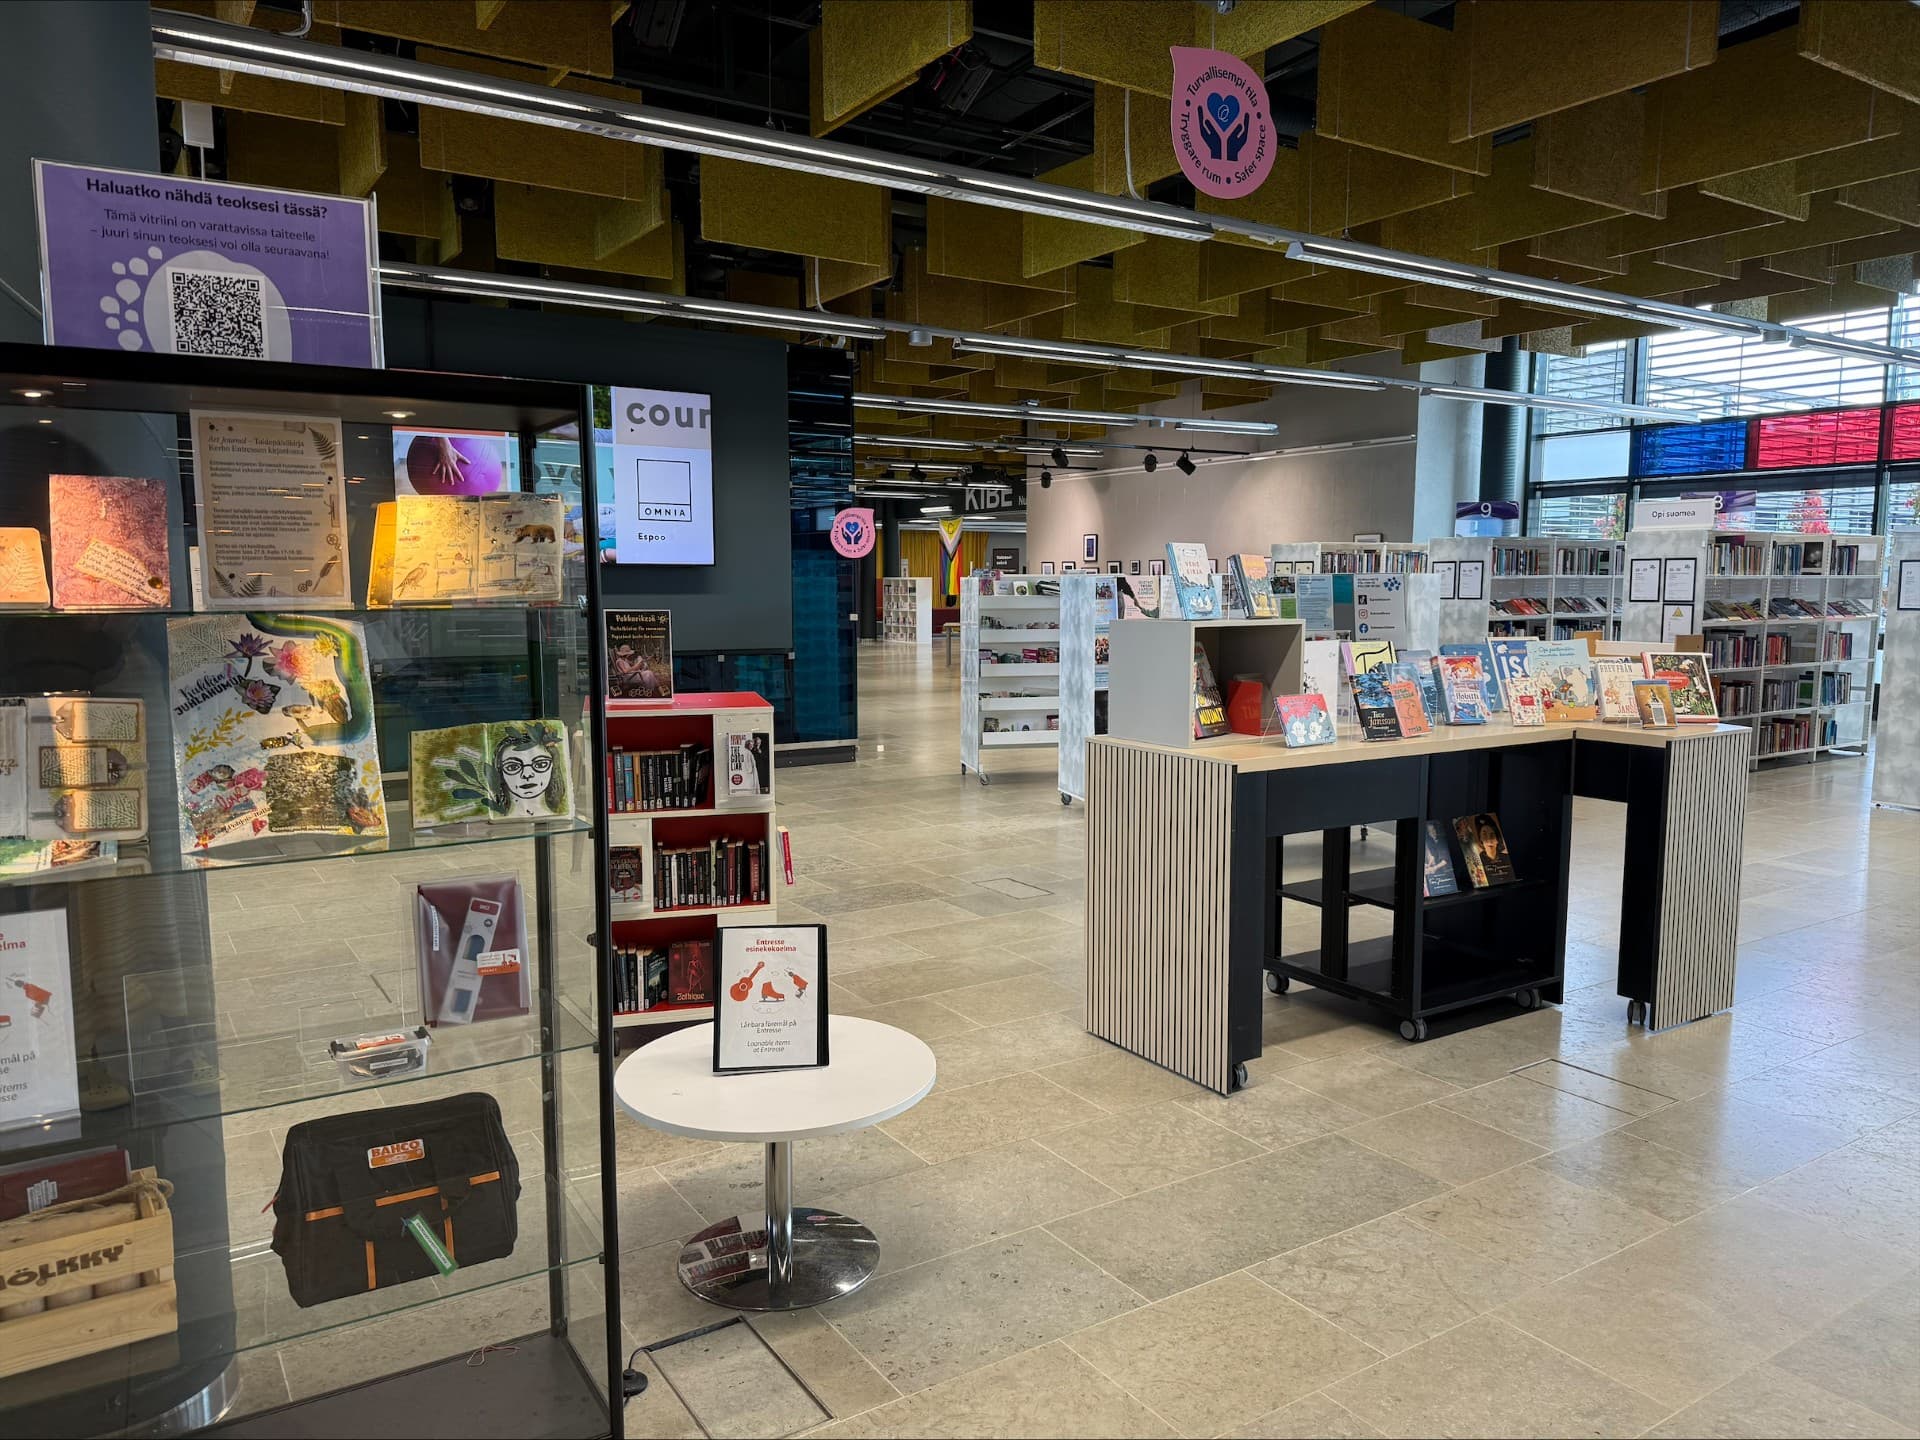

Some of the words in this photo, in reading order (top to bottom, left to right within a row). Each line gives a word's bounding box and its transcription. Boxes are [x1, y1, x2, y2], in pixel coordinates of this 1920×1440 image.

[1186, 65, 1247, 96] Turvallisempi
[1245, 86, 1258, 108] tila
[1179, 111, 1201, 168] Tryggare
[1202, 166, 1222, 184] rum
[1234, 162, 1257, 184] Safer
[1255, 124, 1266, 162] space
[86, 177, 161, 200] Haluatko
[164, 188, 213, 206] nähdä
[216, 192, 279, 213] teoksesi
[282, 200, 328, 219] tässä?
[103, 208, 137, 223] Tämä
[139, 211, 178, 227] vitriini
[181, 218, 197, 230] on
[200, 218, 268, 238] varattavissa
[270, 227, 316, 243] taiteelle
[100, 225, 131, 241] juuri
[132, 228, 166, 244] sinun
[168, 232, 218, 249] teoksesi
[220, 238, 238, 251] voi
[240, 240, 262, 253] olla
[263, 243, 331, 261] seuraavana!
[965, 487, 1013, 511] KIBE
[644, 507, 687, 518] OMNIA
[1480, 502, 1492, 518] 9
[1651, 510, 1665, 520] Opi
[1666, 510, 1696, 518] suomea
[637, 532, 666, 543] Espoo
[173, 674, 247, 716] JUHLAHUMUA
[745, 945, 797, 953] esinekokoelma
[756, 938, 785, 946] Entresse
[740, 1020, 764, 1028] Lånbara
[764, 1019, 788, 1028] föremål
[788, 1019, 797, 1029] på
[371, 1140, 420, 1158] BAHCO
